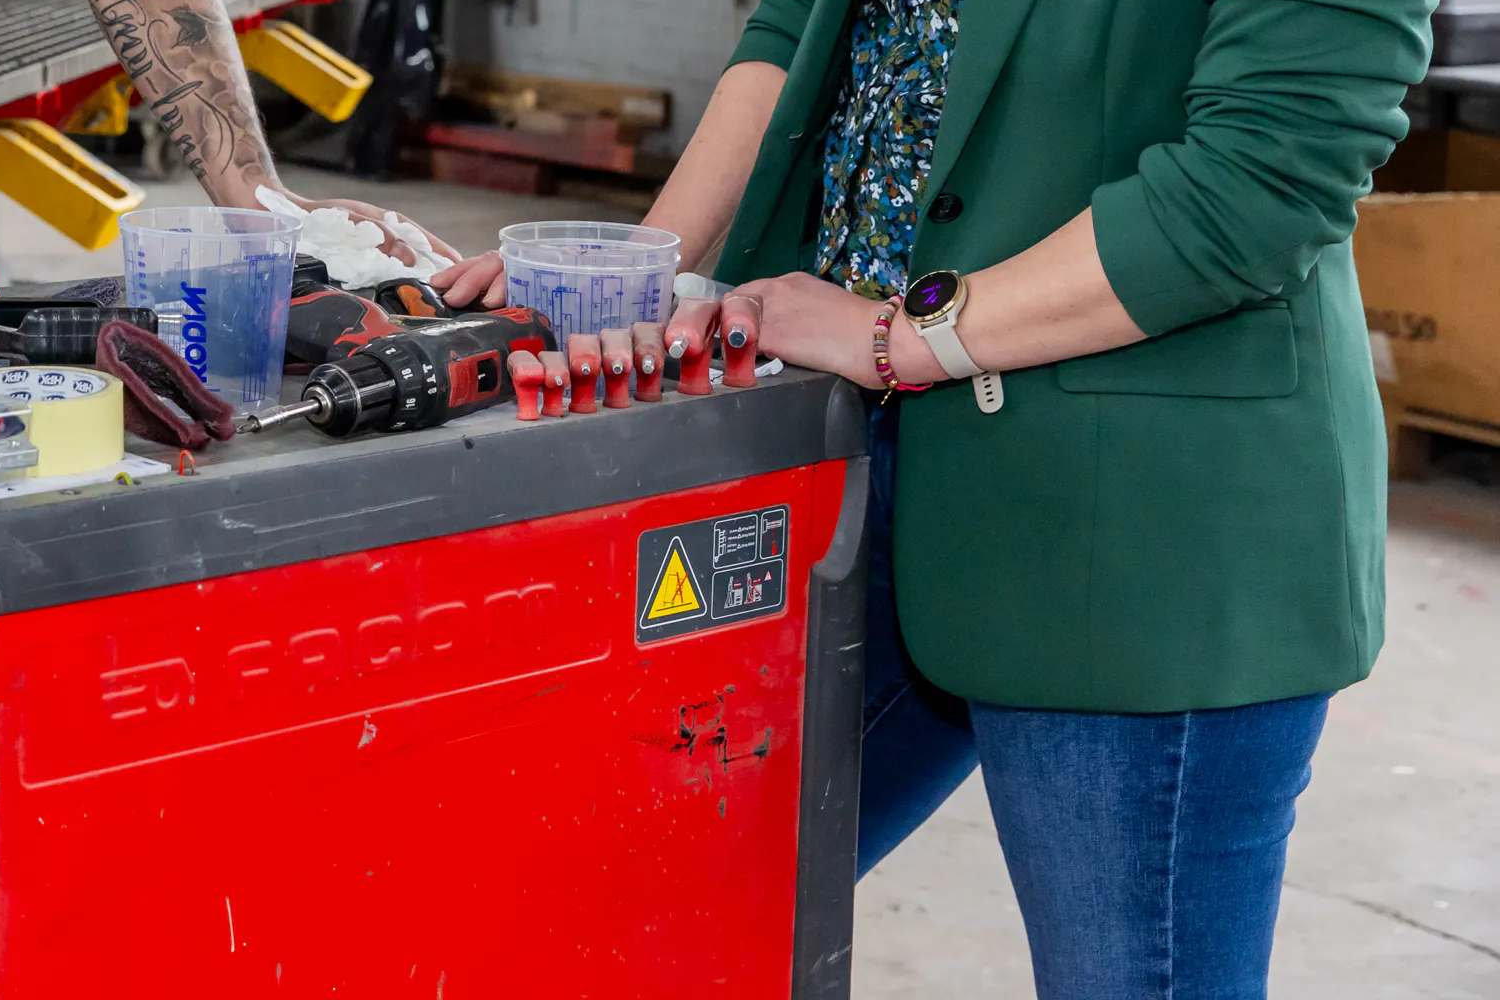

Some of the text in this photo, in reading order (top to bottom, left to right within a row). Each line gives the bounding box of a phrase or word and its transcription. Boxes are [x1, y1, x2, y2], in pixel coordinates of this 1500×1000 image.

[3, 369, 29, 384] HPX
[38, 373, 65, 387] HPX
[401, 367, 414, 381] 18
[73, 380, 94, 394] HPX
[405, 396, 417, 409] 16
